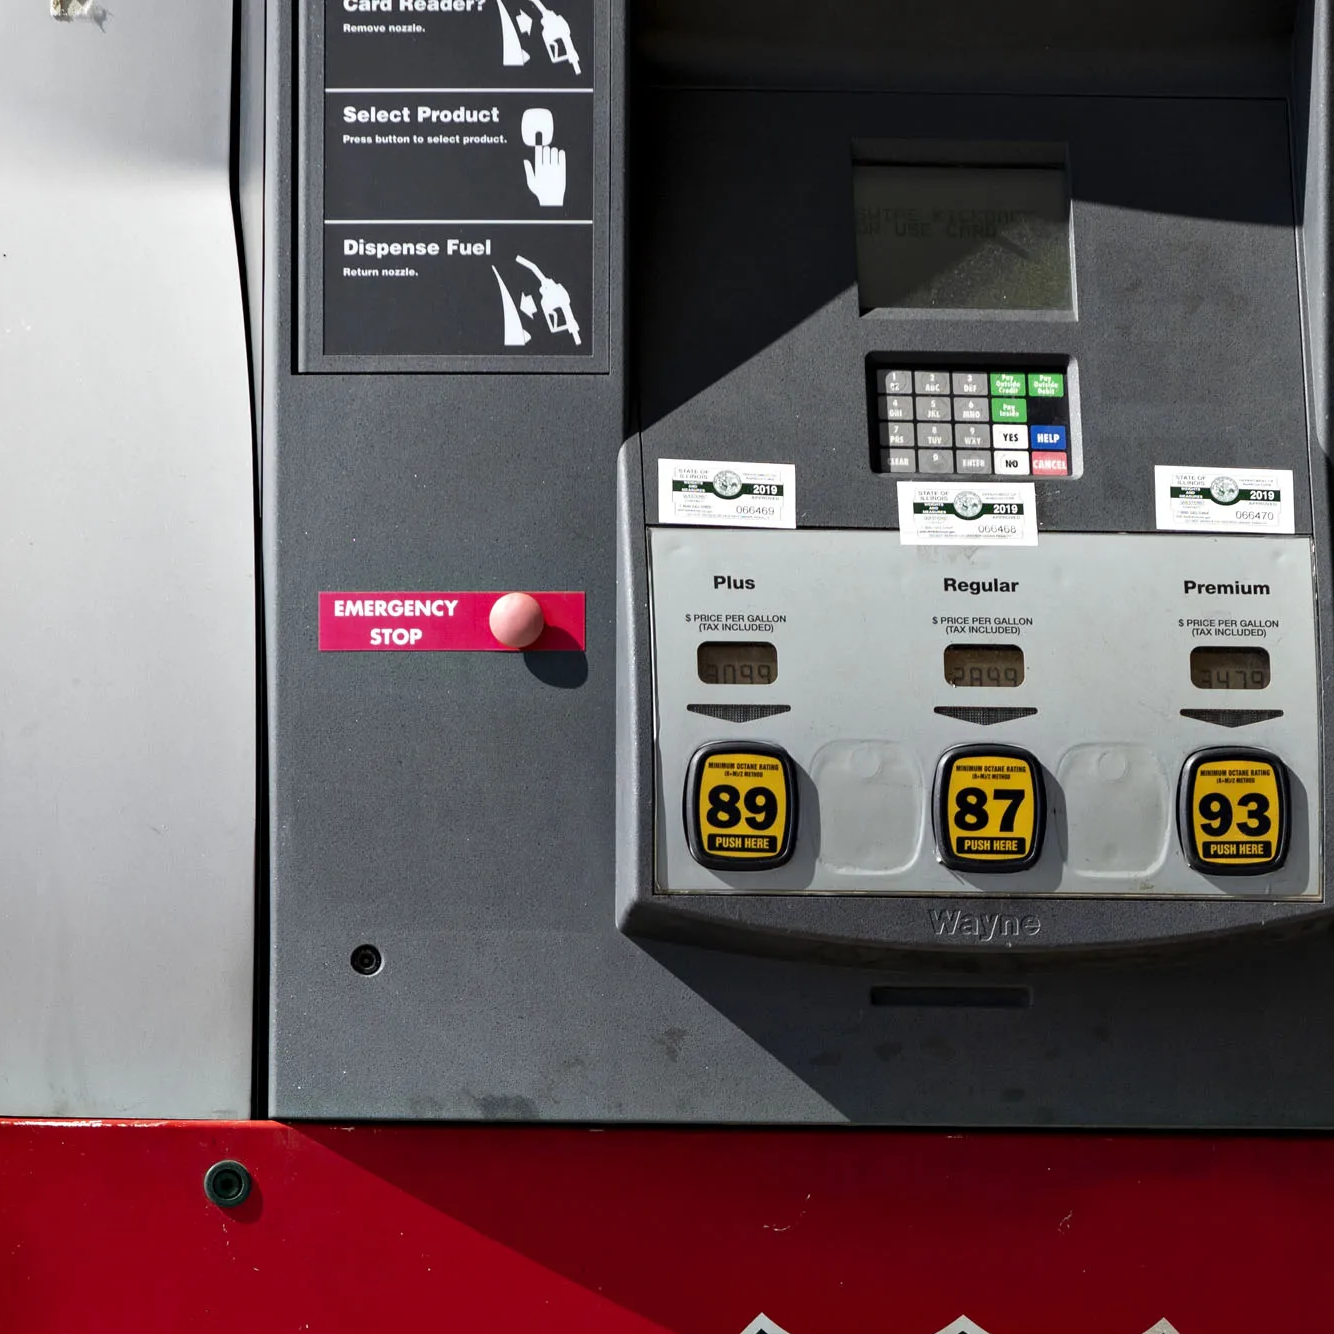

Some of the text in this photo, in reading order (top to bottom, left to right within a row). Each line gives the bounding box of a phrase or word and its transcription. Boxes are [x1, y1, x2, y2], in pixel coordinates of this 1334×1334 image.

[343, 0, 486, 12] Card Reader?
[343, 23, 426, 33] Remove nozzle.
[343, 106, 499, 123] Select Product
[343, 134, 507, 146] Press button to select product.
[343, 239, 491, 259] Dispense Fuel
[343, 267, 418, 277] Return nozzle.
[968, 374, 972, 382] 3
[893, 399, 897, 407] 4
[894, 425, 899, 433] 7
[970, 427, 974, 435] 9
[1003, 433, 1019, 442] YES
[1037, 433, 1060, 443] HELP
[1006, 460, 1018, 468] NO
[1033, 460, 1067, 469] CANCEL
[753, 485, 777, 495] 2019
[1250, 491, 1275, 500] 2019
[736, 505, 774, 515] 066469
[993, 504, 1018, 514] 2019
[1236, 511, 1274, 520] 066470
[713, 575, 756, 590] Plus
[943, 578, 1019, 595] Regular
[1184, 580, 1270, 595] Premium
[334, 600, 458, 616] EMERGENCY
[685, 614, 786, 623] $ PRICE PER GALLON
[932, 617, 1033, 626] $ PRICE PER GALLON
[1178, 619, 1279, 628] $ PRICE PER GALLON
[699, 623, 774, 633] (TAX INCLUDED)
[945, 626, 1020, 635] (TAX INCLUDED)
[1191, 628, 1267, 638] (TAX INCLUDED)
[370, 628, 422, 645] STOP
[709, 762, 779, 771] MINIMUM OCTANE RATING
[707, 784, 778, 831] 89
[954, 787, 1026, 832] 87
[1199, 792, 1272, 837] 93
[716, 837, 769, 849] PUSH HERE
[964, 839, 1018, 851] PUSH HERE
[1210, 844, 1264, 855] PUSH HERE
[928, 909, 1042, 941] Wayne
